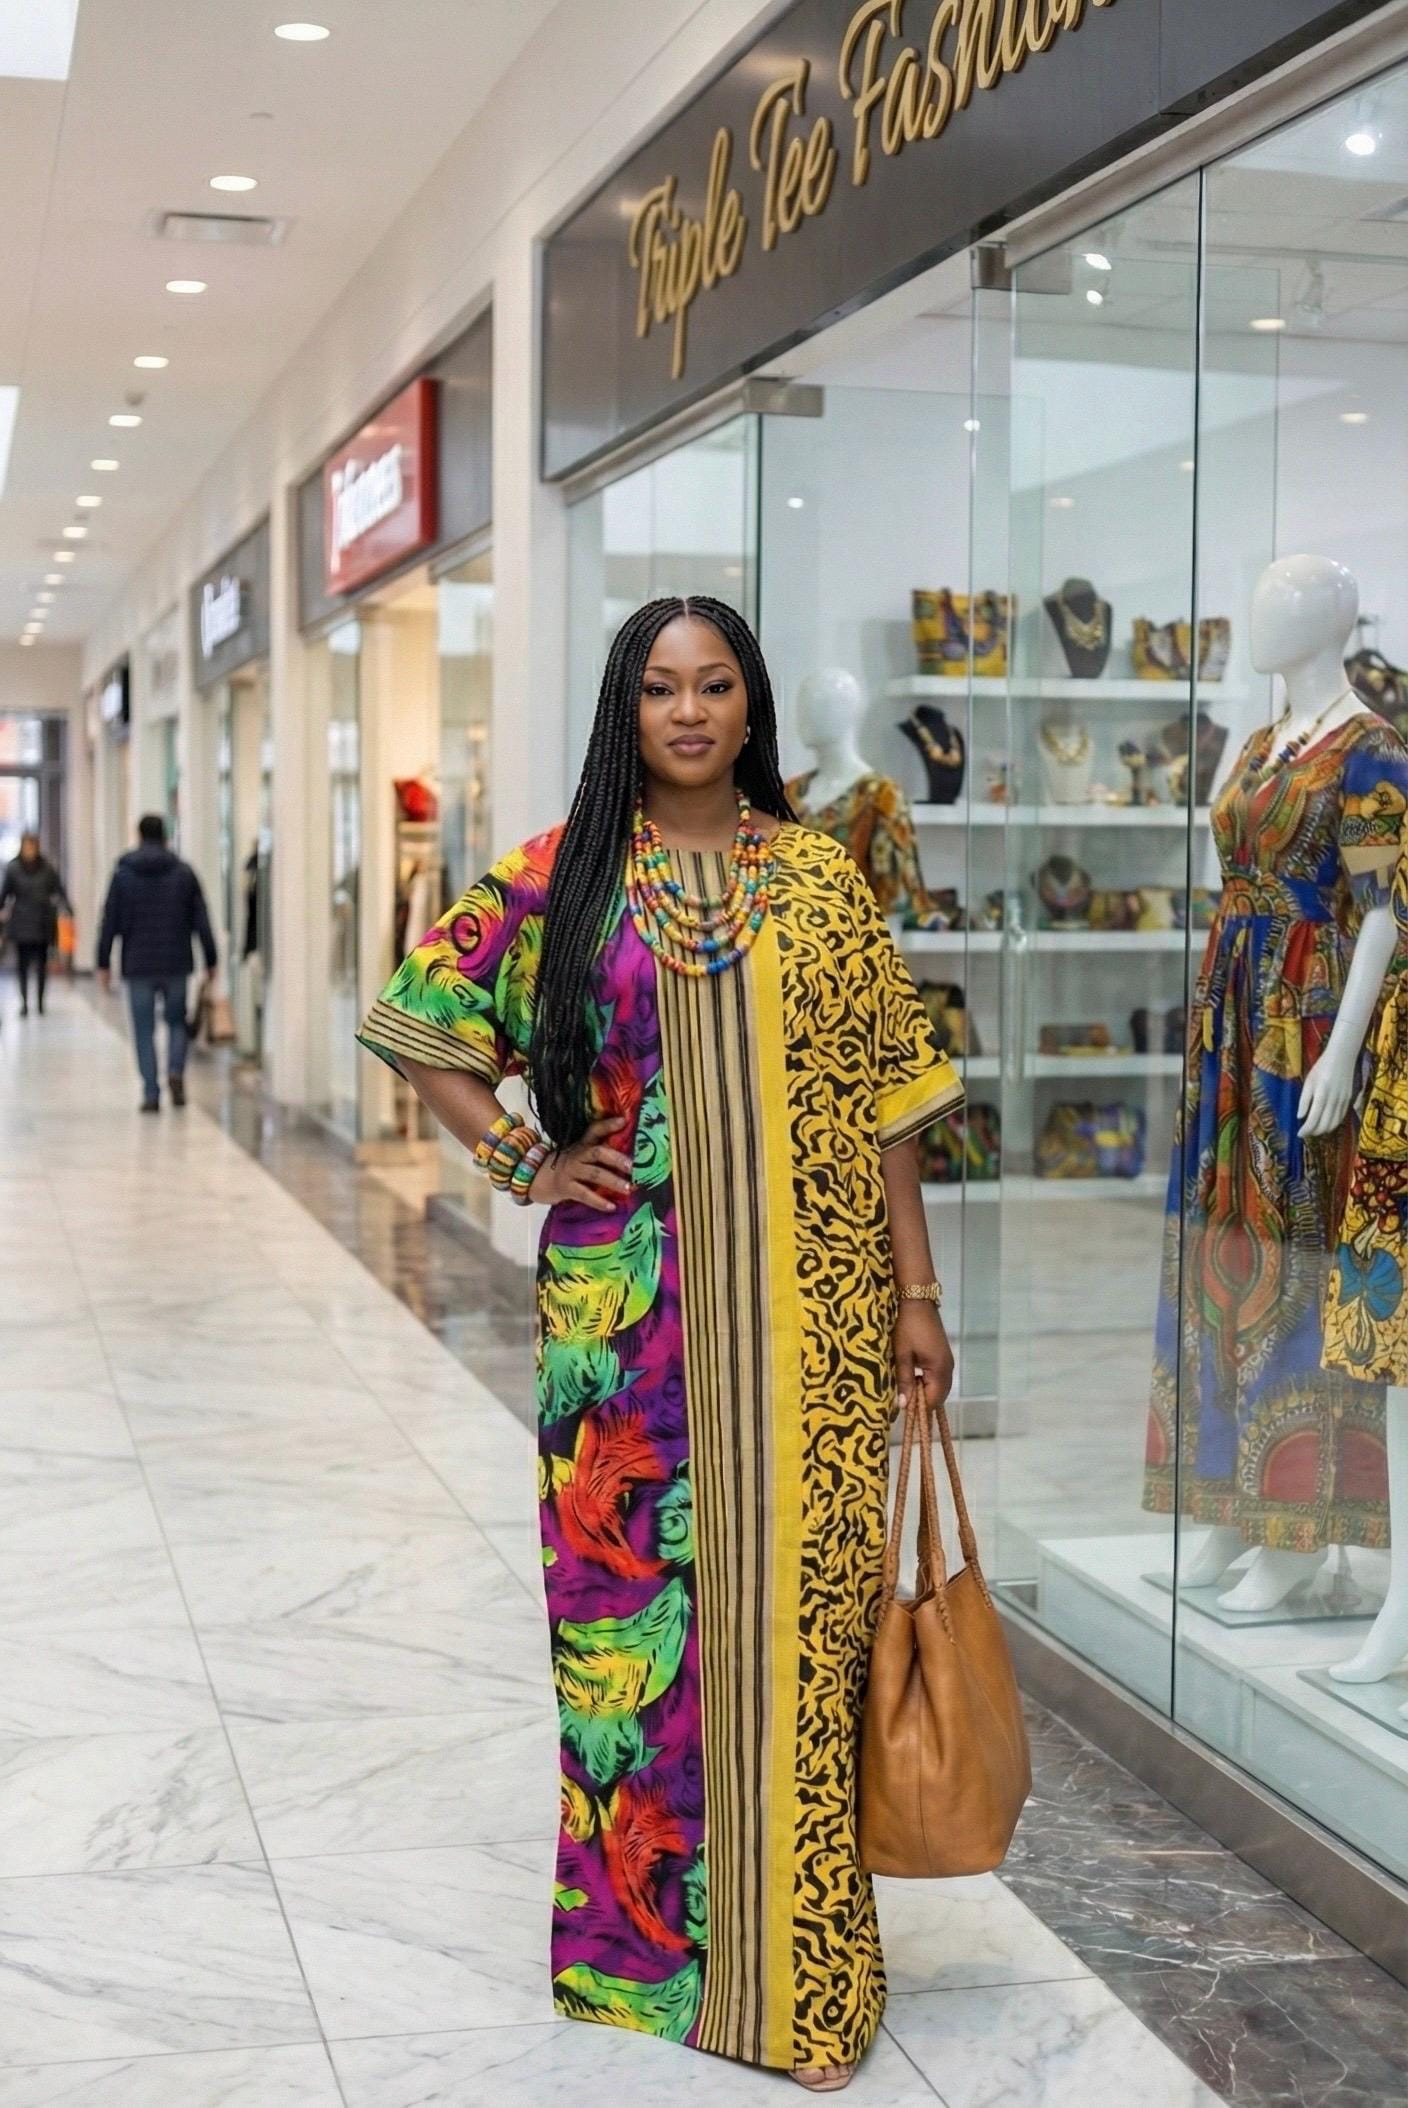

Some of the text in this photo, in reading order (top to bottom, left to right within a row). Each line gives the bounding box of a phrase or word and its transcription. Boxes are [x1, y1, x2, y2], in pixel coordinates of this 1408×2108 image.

[629, 0, 1114, 380] Triple Tee Fashi
